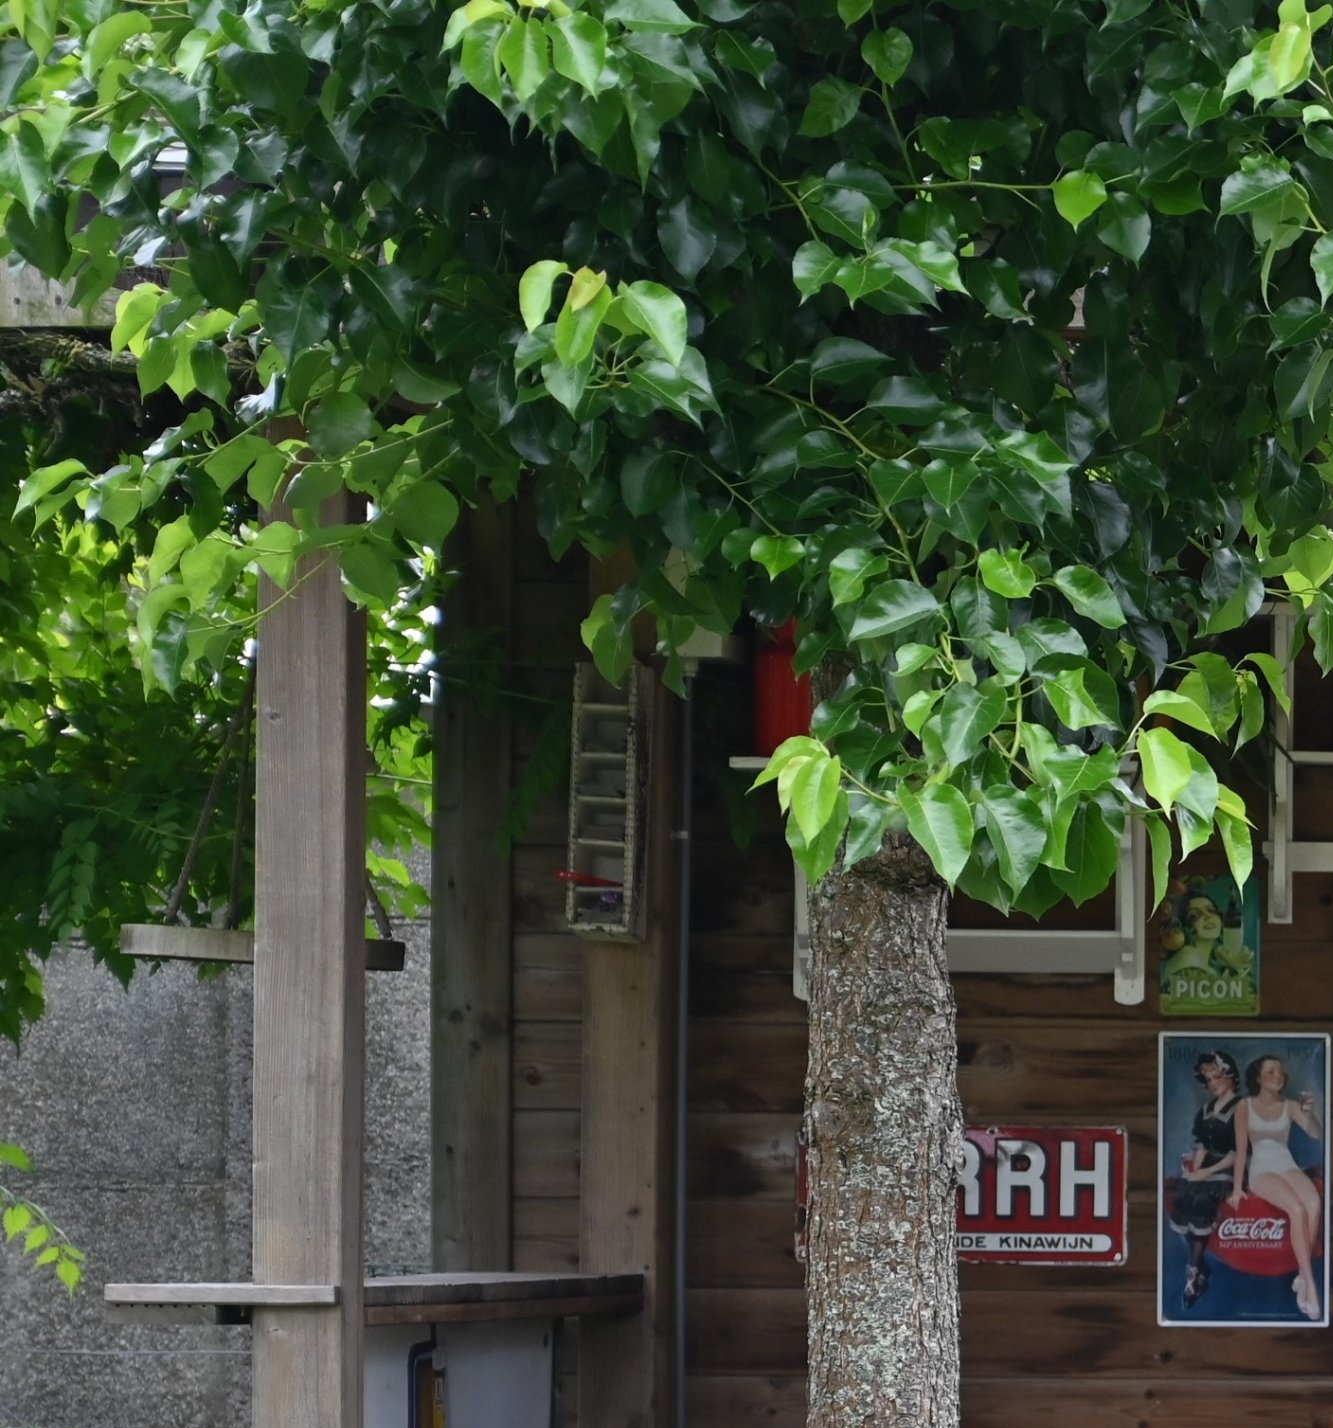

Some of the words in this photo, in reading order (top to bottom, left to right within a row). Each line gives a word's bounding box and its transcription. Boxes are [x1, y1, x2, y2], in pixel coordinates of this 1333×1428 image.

[1176, 980, 1243, 999] PICON
[1218, 1217, 1286, 1240] Coca-Cola
[1000, 1236, 1093, 1249] KINAWIJN
